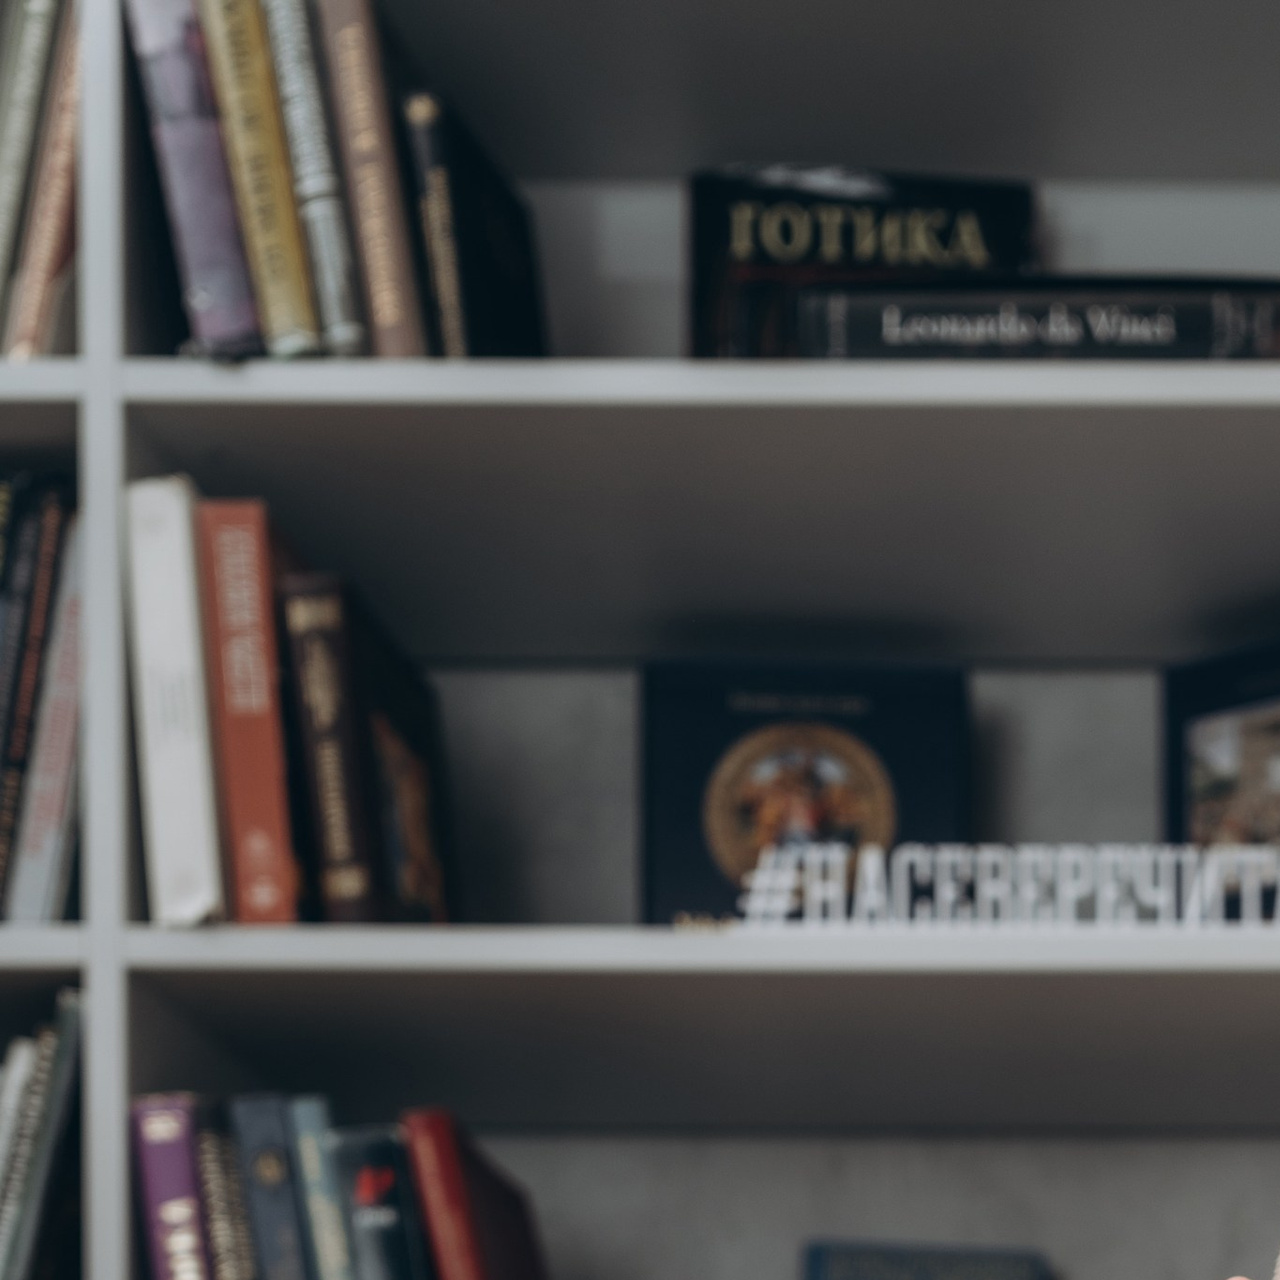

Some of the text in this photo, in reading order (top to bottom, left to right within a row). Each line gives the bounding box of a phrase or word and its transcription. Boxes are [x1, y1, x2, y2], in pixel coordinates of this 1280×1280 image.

[729, 201, 990, 269] ГОТИКА
[881, 302, 1036, 346] Leonardo
[1039, 303, 1082, 345] da
[1086, 304, 1176, 345] Vinci
